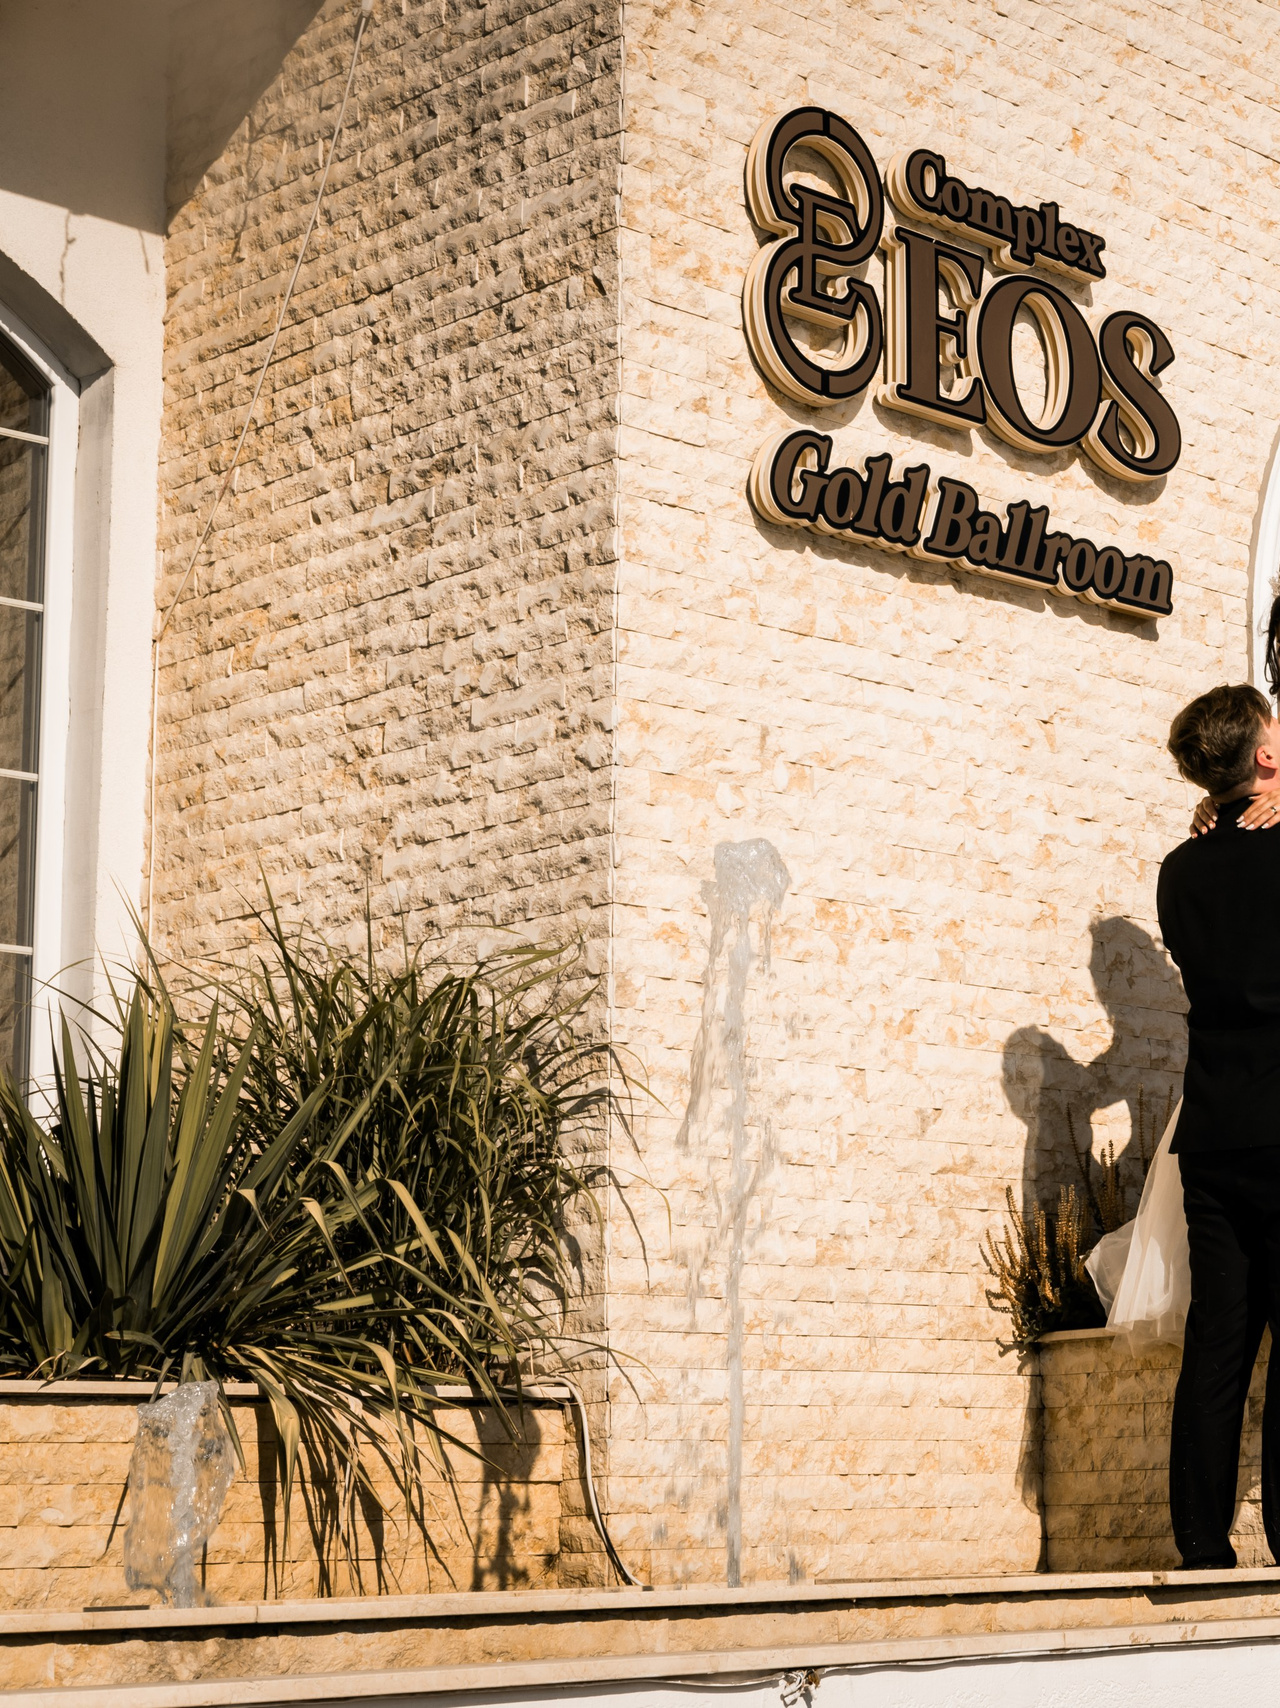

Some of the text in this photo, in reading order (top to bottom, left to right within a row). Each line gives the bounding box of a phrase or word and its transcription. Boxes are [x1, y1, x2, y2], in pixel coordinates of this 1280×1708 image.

[905, 149, 1106, 279] Complex
[895, 226, 1181, 476] EOS
[770, 430, 1174, 616] Gold Ballroom
